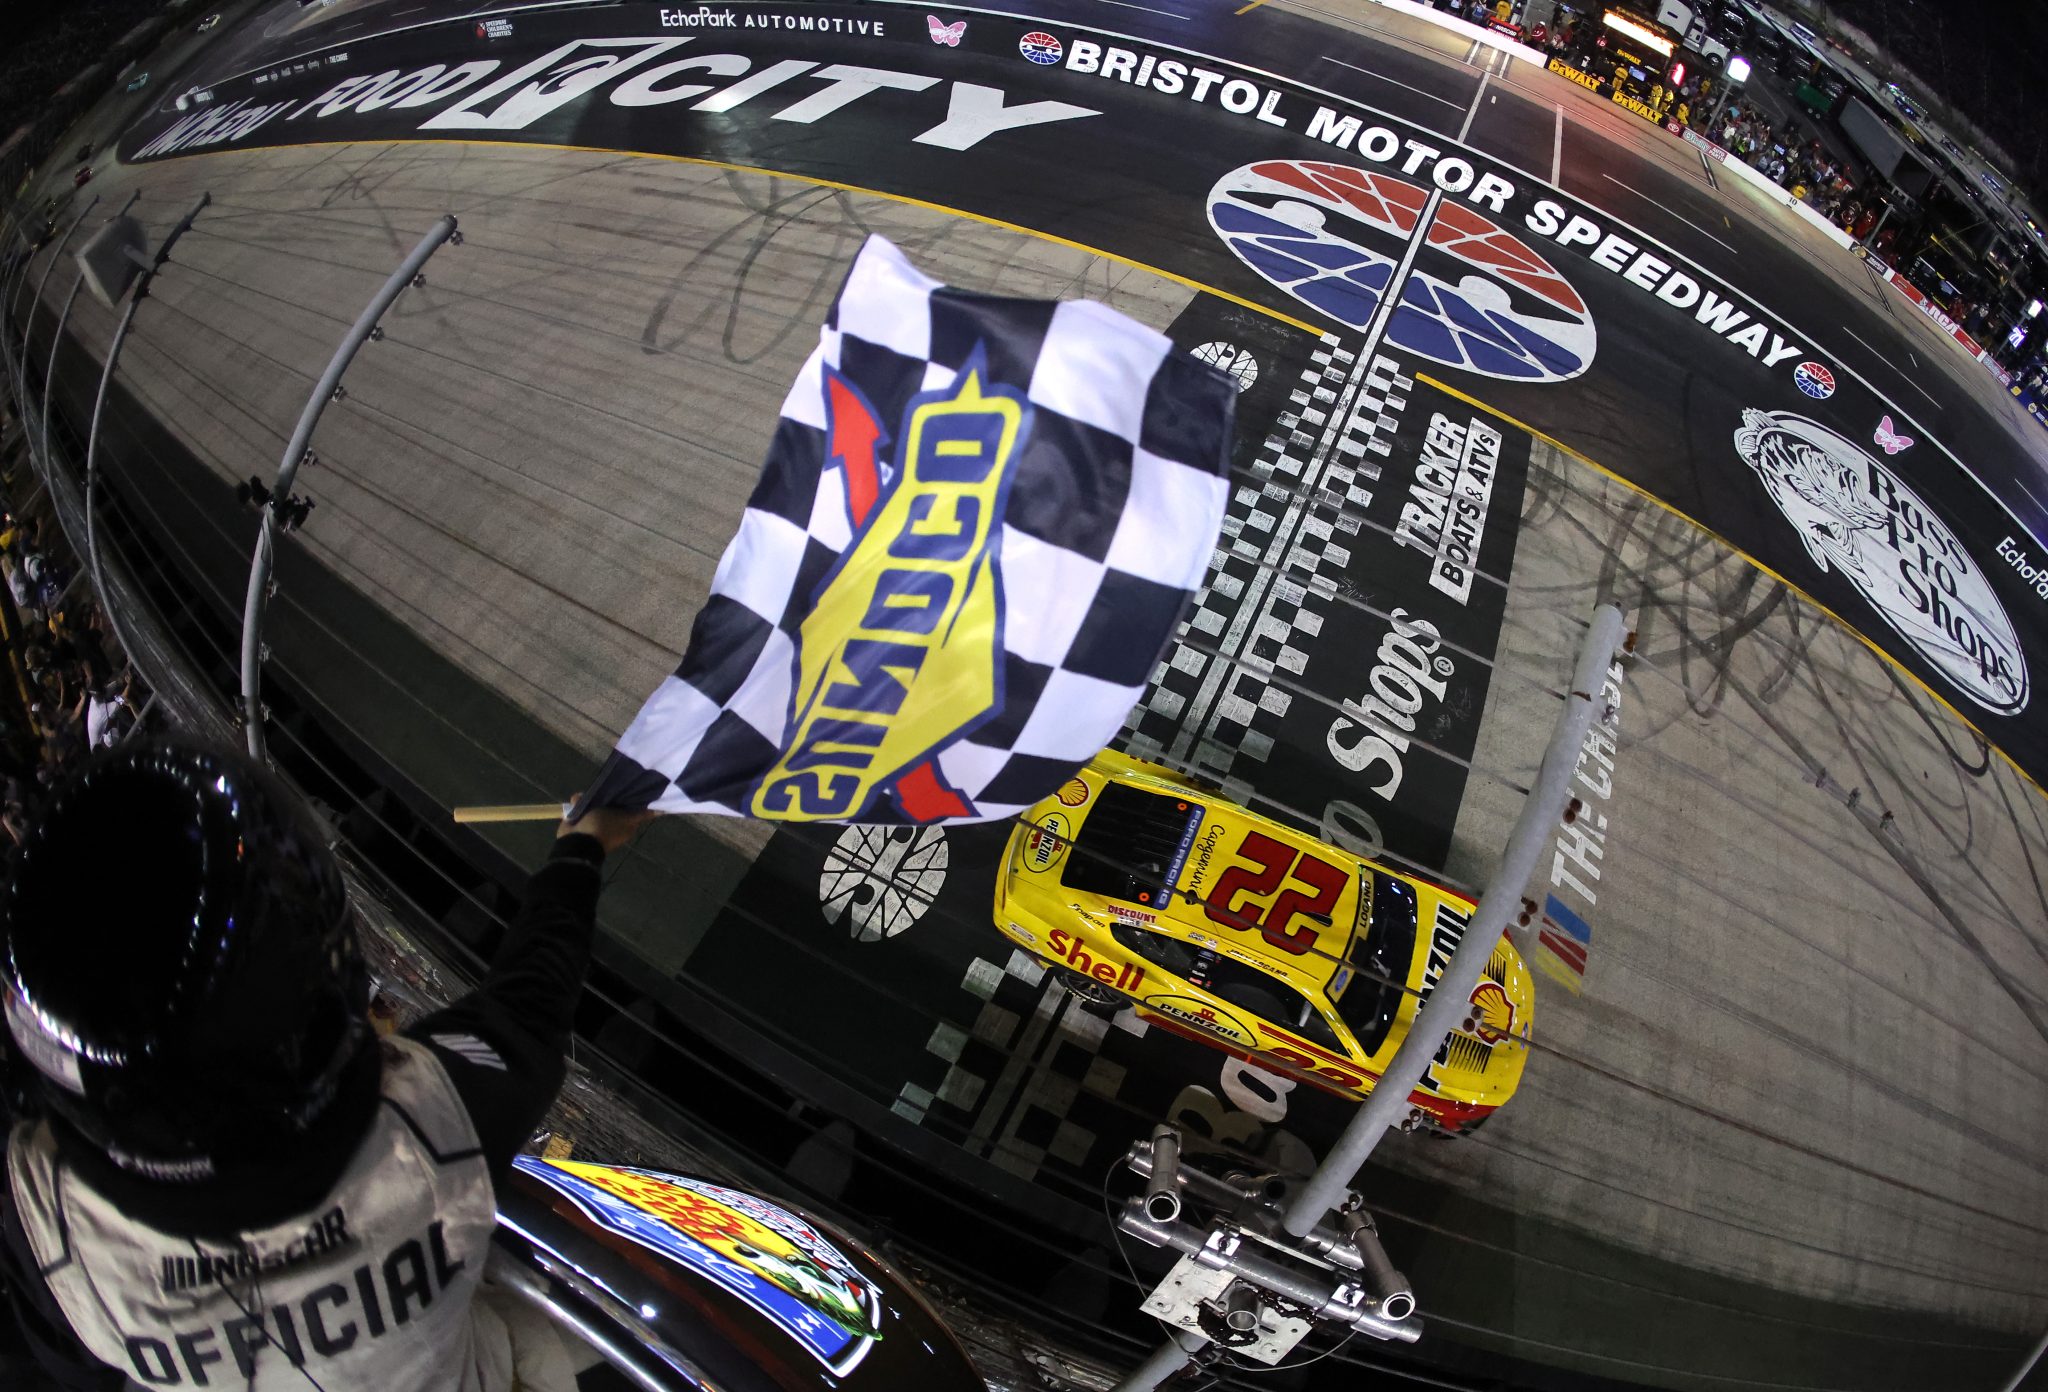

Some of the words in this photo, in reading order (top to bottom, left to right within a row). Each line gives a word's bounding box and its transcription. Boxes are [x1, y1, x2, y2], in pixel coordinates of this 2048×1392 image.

[659, 6, 737, 28] EchoPark
[744, 14, 885, 37] AUTOMOTIVE
[1495, 23, 1518, 37] NASCAR
[285, 59, 502, 122] FOOD
[609, 53, 1104, 151] CITY
[1065, 39, 1288, 128] BRISTOL
[1305, 105, 1516, 214] MOTOR
[1525, 199, 1804, 370] SPEEDWAY
[1788, 196, 1798, 207] 10
[1392, 411, 1469, 559] TRACKER
[1474, 432, 1497, 486] ATVs
[1465, 485, 1484, 502] &
[1867, 460, 1968, 576] Bass
[1439, 498, 1481, 589] BOATS
[1885, 512, 1957, 598] Pro
[1898, 558, 2019, 697] Shops
[1181, 809, 1202, 848] FORD
[1189, 824, 1226, 890] Capgemini
[1106, 903, 1157, 924] DISCOUNT
[1204, 829, 1350, 956] 22
[1359, 879, 1373, 930] LOGANO
[1046, 927, 1147, 994] Shell
[1159, 1002, 1242, 1040] PENNZOIL
[123, 1217, 466, 1388] OFFICIAL
